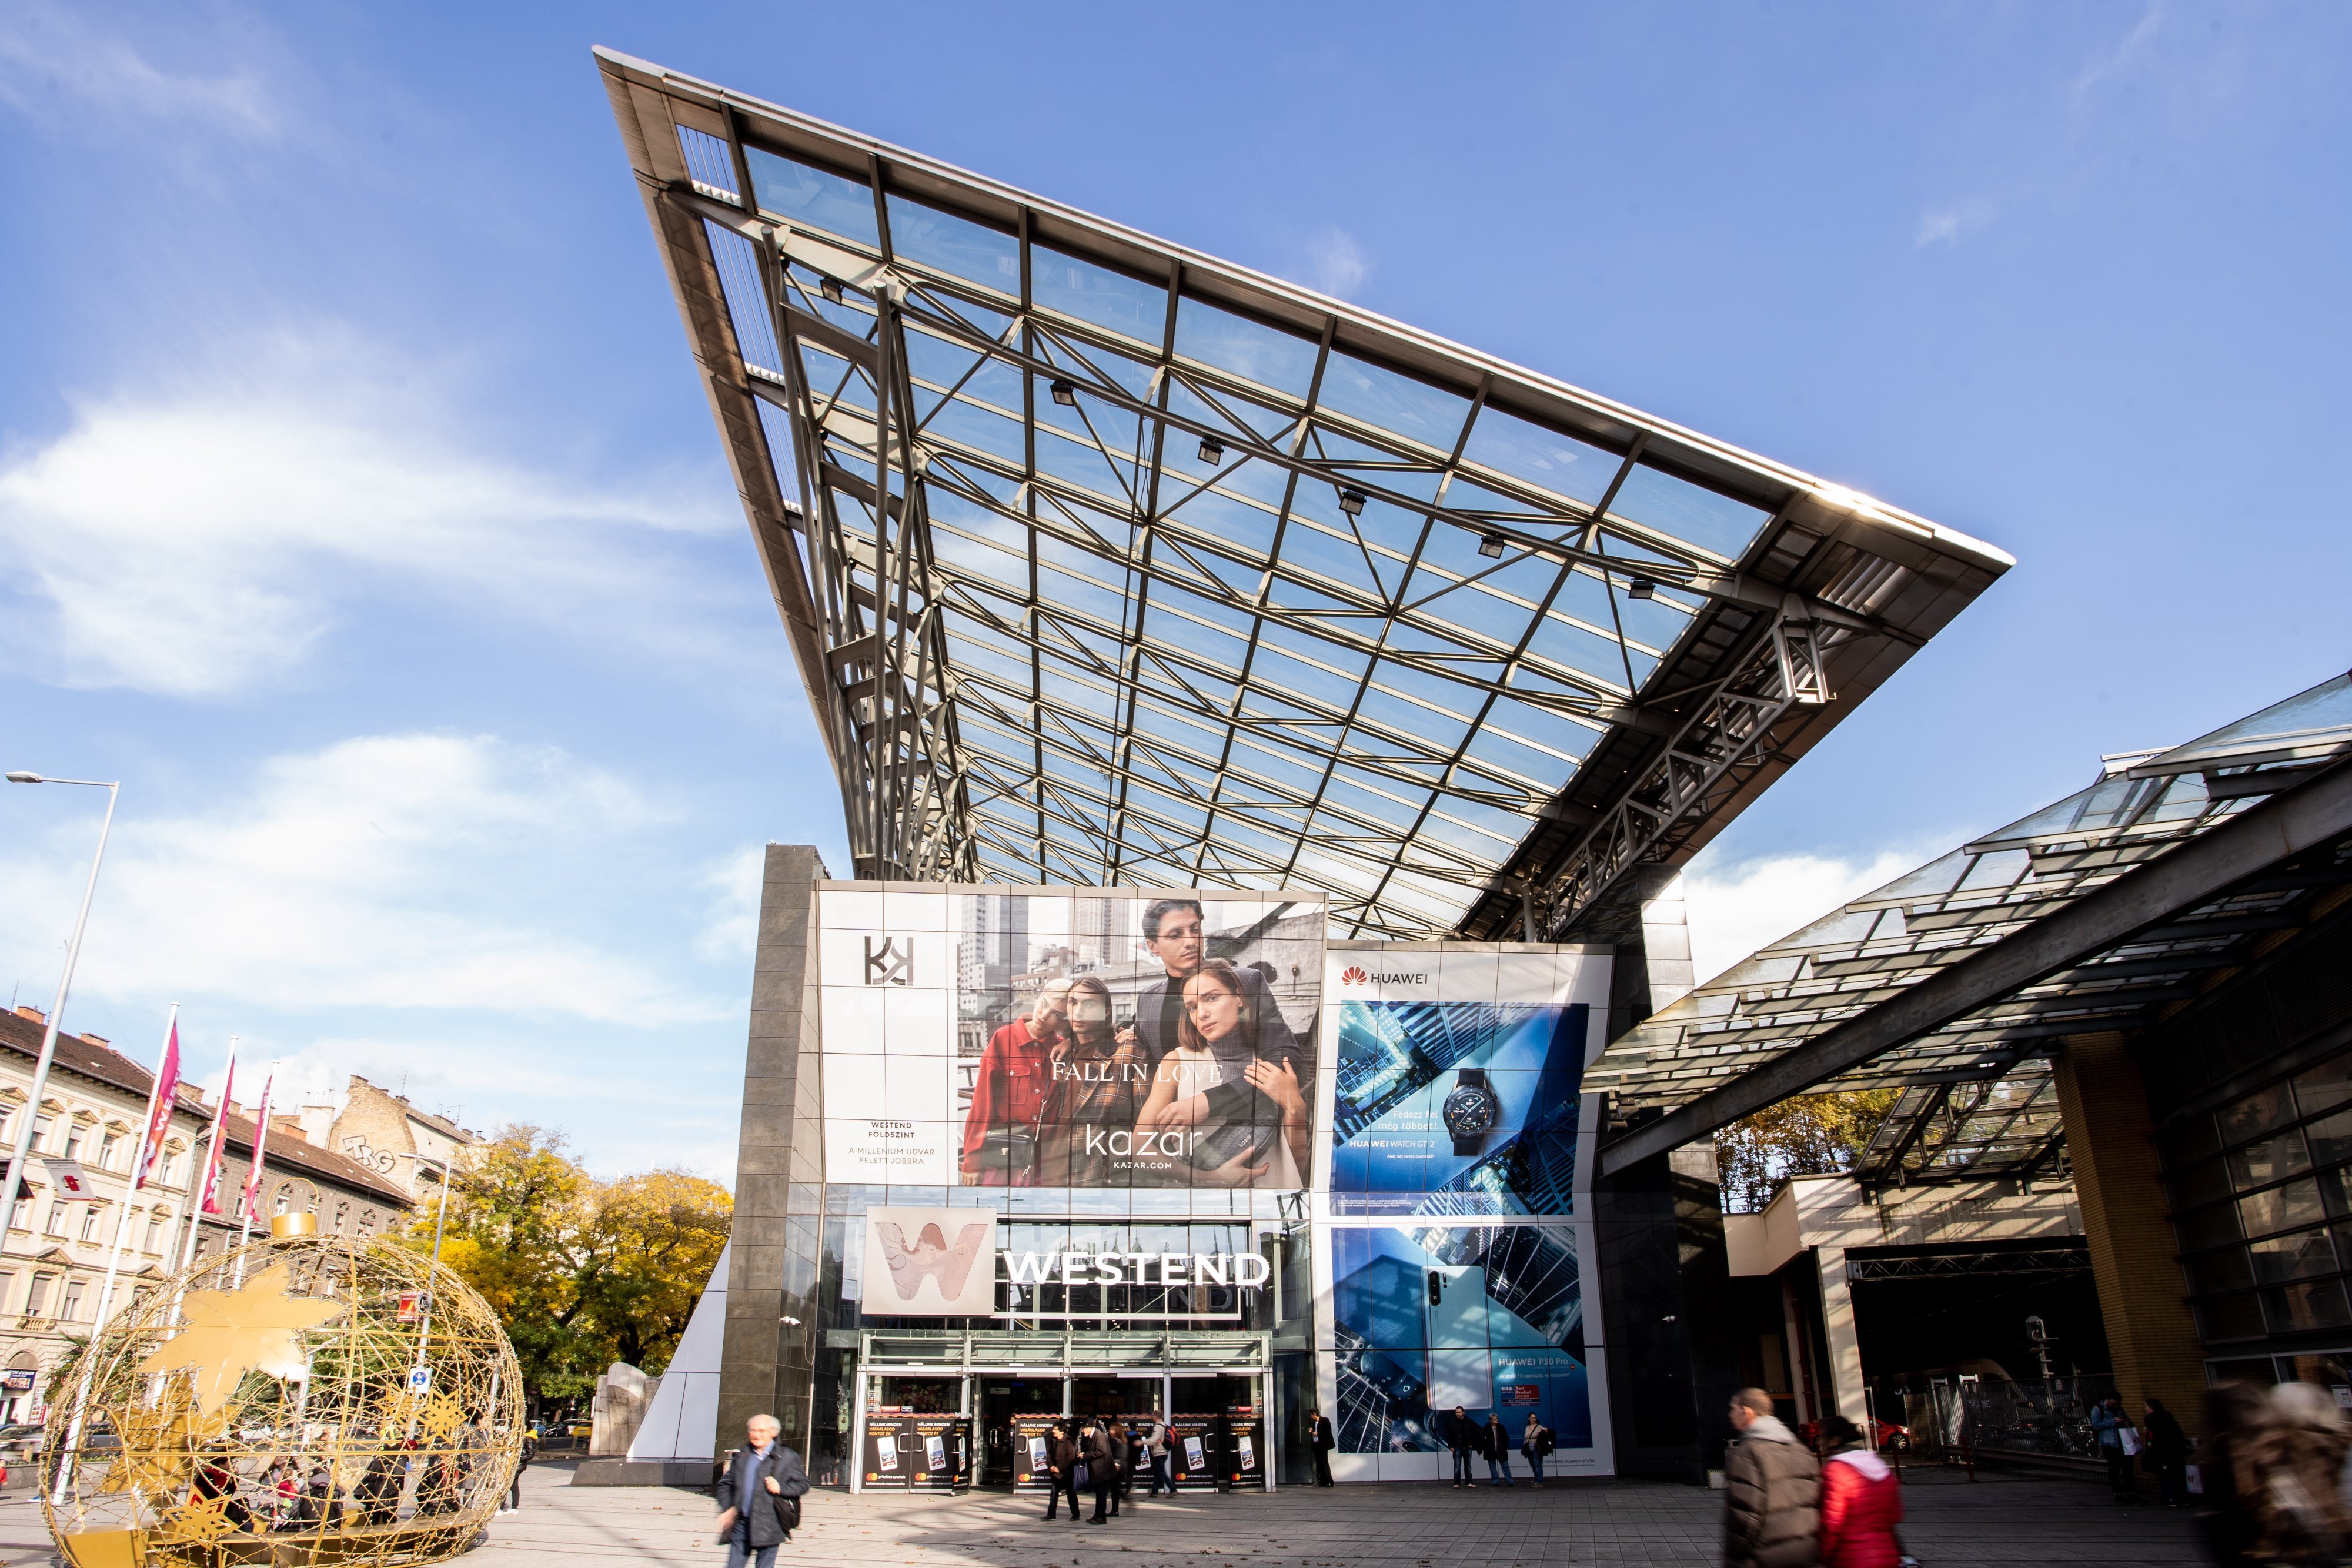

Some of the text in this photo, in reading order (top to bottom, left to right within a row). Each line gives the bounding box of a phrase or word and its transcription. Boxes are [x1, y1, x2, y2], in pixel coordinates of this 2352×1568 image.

[1371, 973, 1428, 984] HUAWEI
[1052, 1062, 1223, 1083] FALL IN LOVE
[1394, 1110, 1438, 1119] Fedezz fel
[1378, 1122, 1398, 1131] még
[1086, 1124, 1202, 1156] kazar
[1238, 1134, 1251, 1148] kazar
[1003, 1251, 1272, 1286] WESTEND
